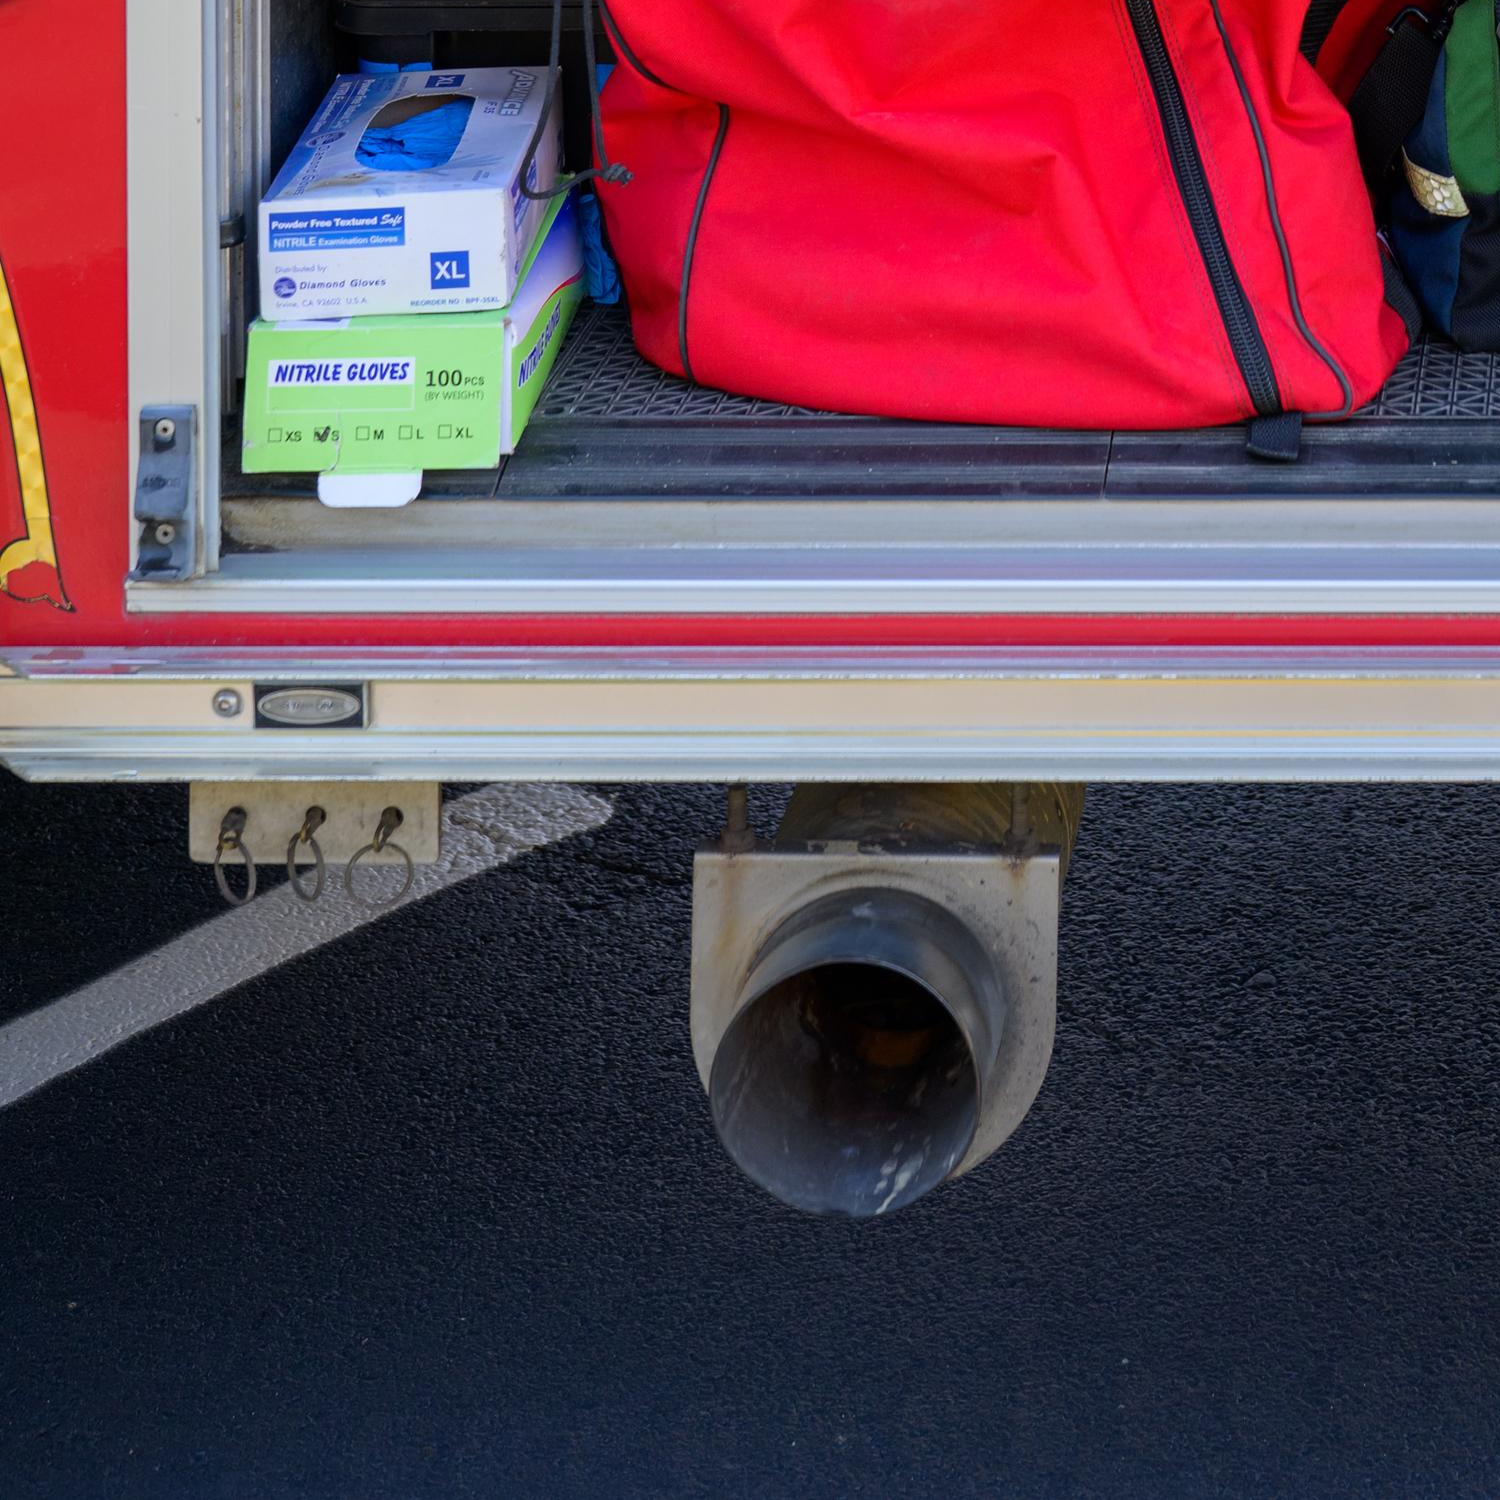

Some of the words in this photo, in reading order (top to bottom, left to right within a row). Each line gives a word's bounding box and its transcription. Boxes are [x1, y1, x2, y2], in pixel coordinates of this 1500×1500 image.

[434, 76, 456, 86] XL
[272, 220, 308, 230] Powder
[310, 218, 331, 228] Free
[334, 216, 377, 226] Textured
[380, 213, 402, 226] Soft
[273, 236, 316, 249] NITRILE
[318, 236, 368, 246] Examination
[370, 234, 398, 244] Gloves
[275, 265, 315, 274] Distributed
[318, 265, 327, 274] by
[435, 261, 466, 280] XL
[300, 280, 345, 290] Diamond
[351, 278, 386, 288] Gloves
[410, 299, 446, 307] REORDER
[518, 332, 544, 388] NITRILE
[275, 364, 342, 383] NITRILE
[347, 362, 409, 381] GLOVES
[425, 370, 462, 387] 100
[464, 377, 485, 386] PCS
[425, 391, 440, 401] (BY
[444, 390, 485, 400] WEIGHT)
[285, 431, 302, 442] XS
[331, 430, 340, 441] S
[373, 429, 384, 440] M
[416, 429, 424, 440] L
[455, 428, 473, 438] XL
